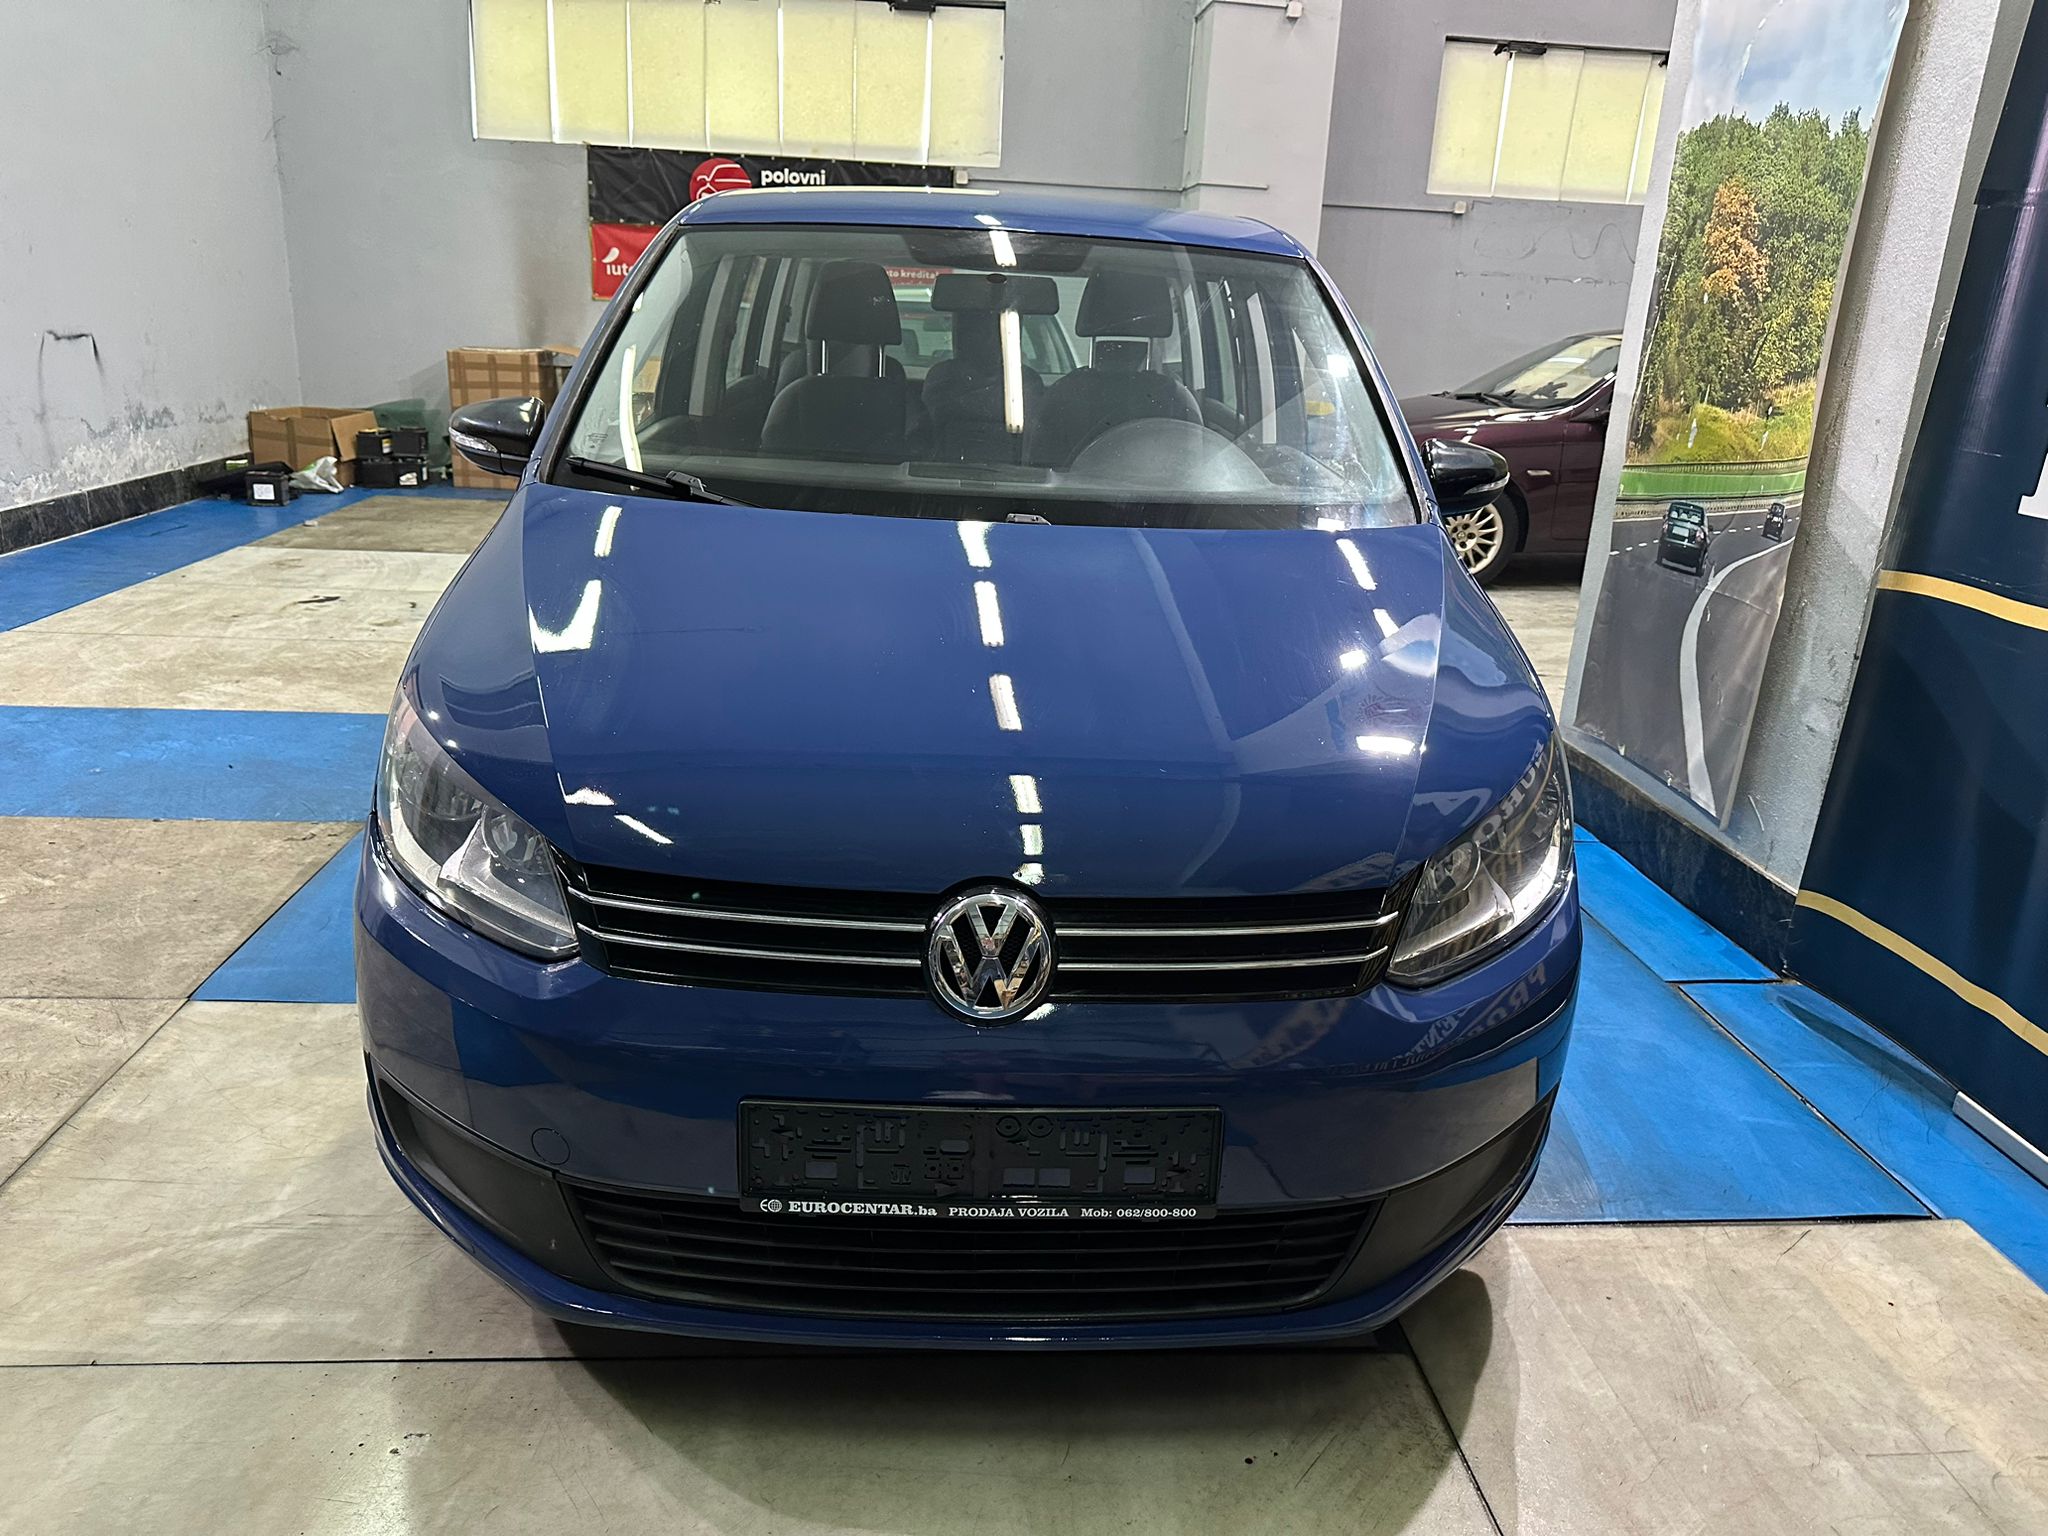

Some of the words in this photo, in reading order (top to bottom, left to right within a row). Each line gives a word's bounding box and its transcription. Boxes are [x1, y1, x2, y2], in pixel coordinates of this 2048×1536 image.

[761, 168, 826, 186] polovni
[788, 1201, 938, 1217] EUROCENTAR.ba
[949, 1206, 1014, 1218] PRODAJA
[1018, 1207, 1069, 1218] VOZILA
[1080, 1208, 1113, 1218] Mob:
[1116, 1208, 1197, 1218] 062/800-800
